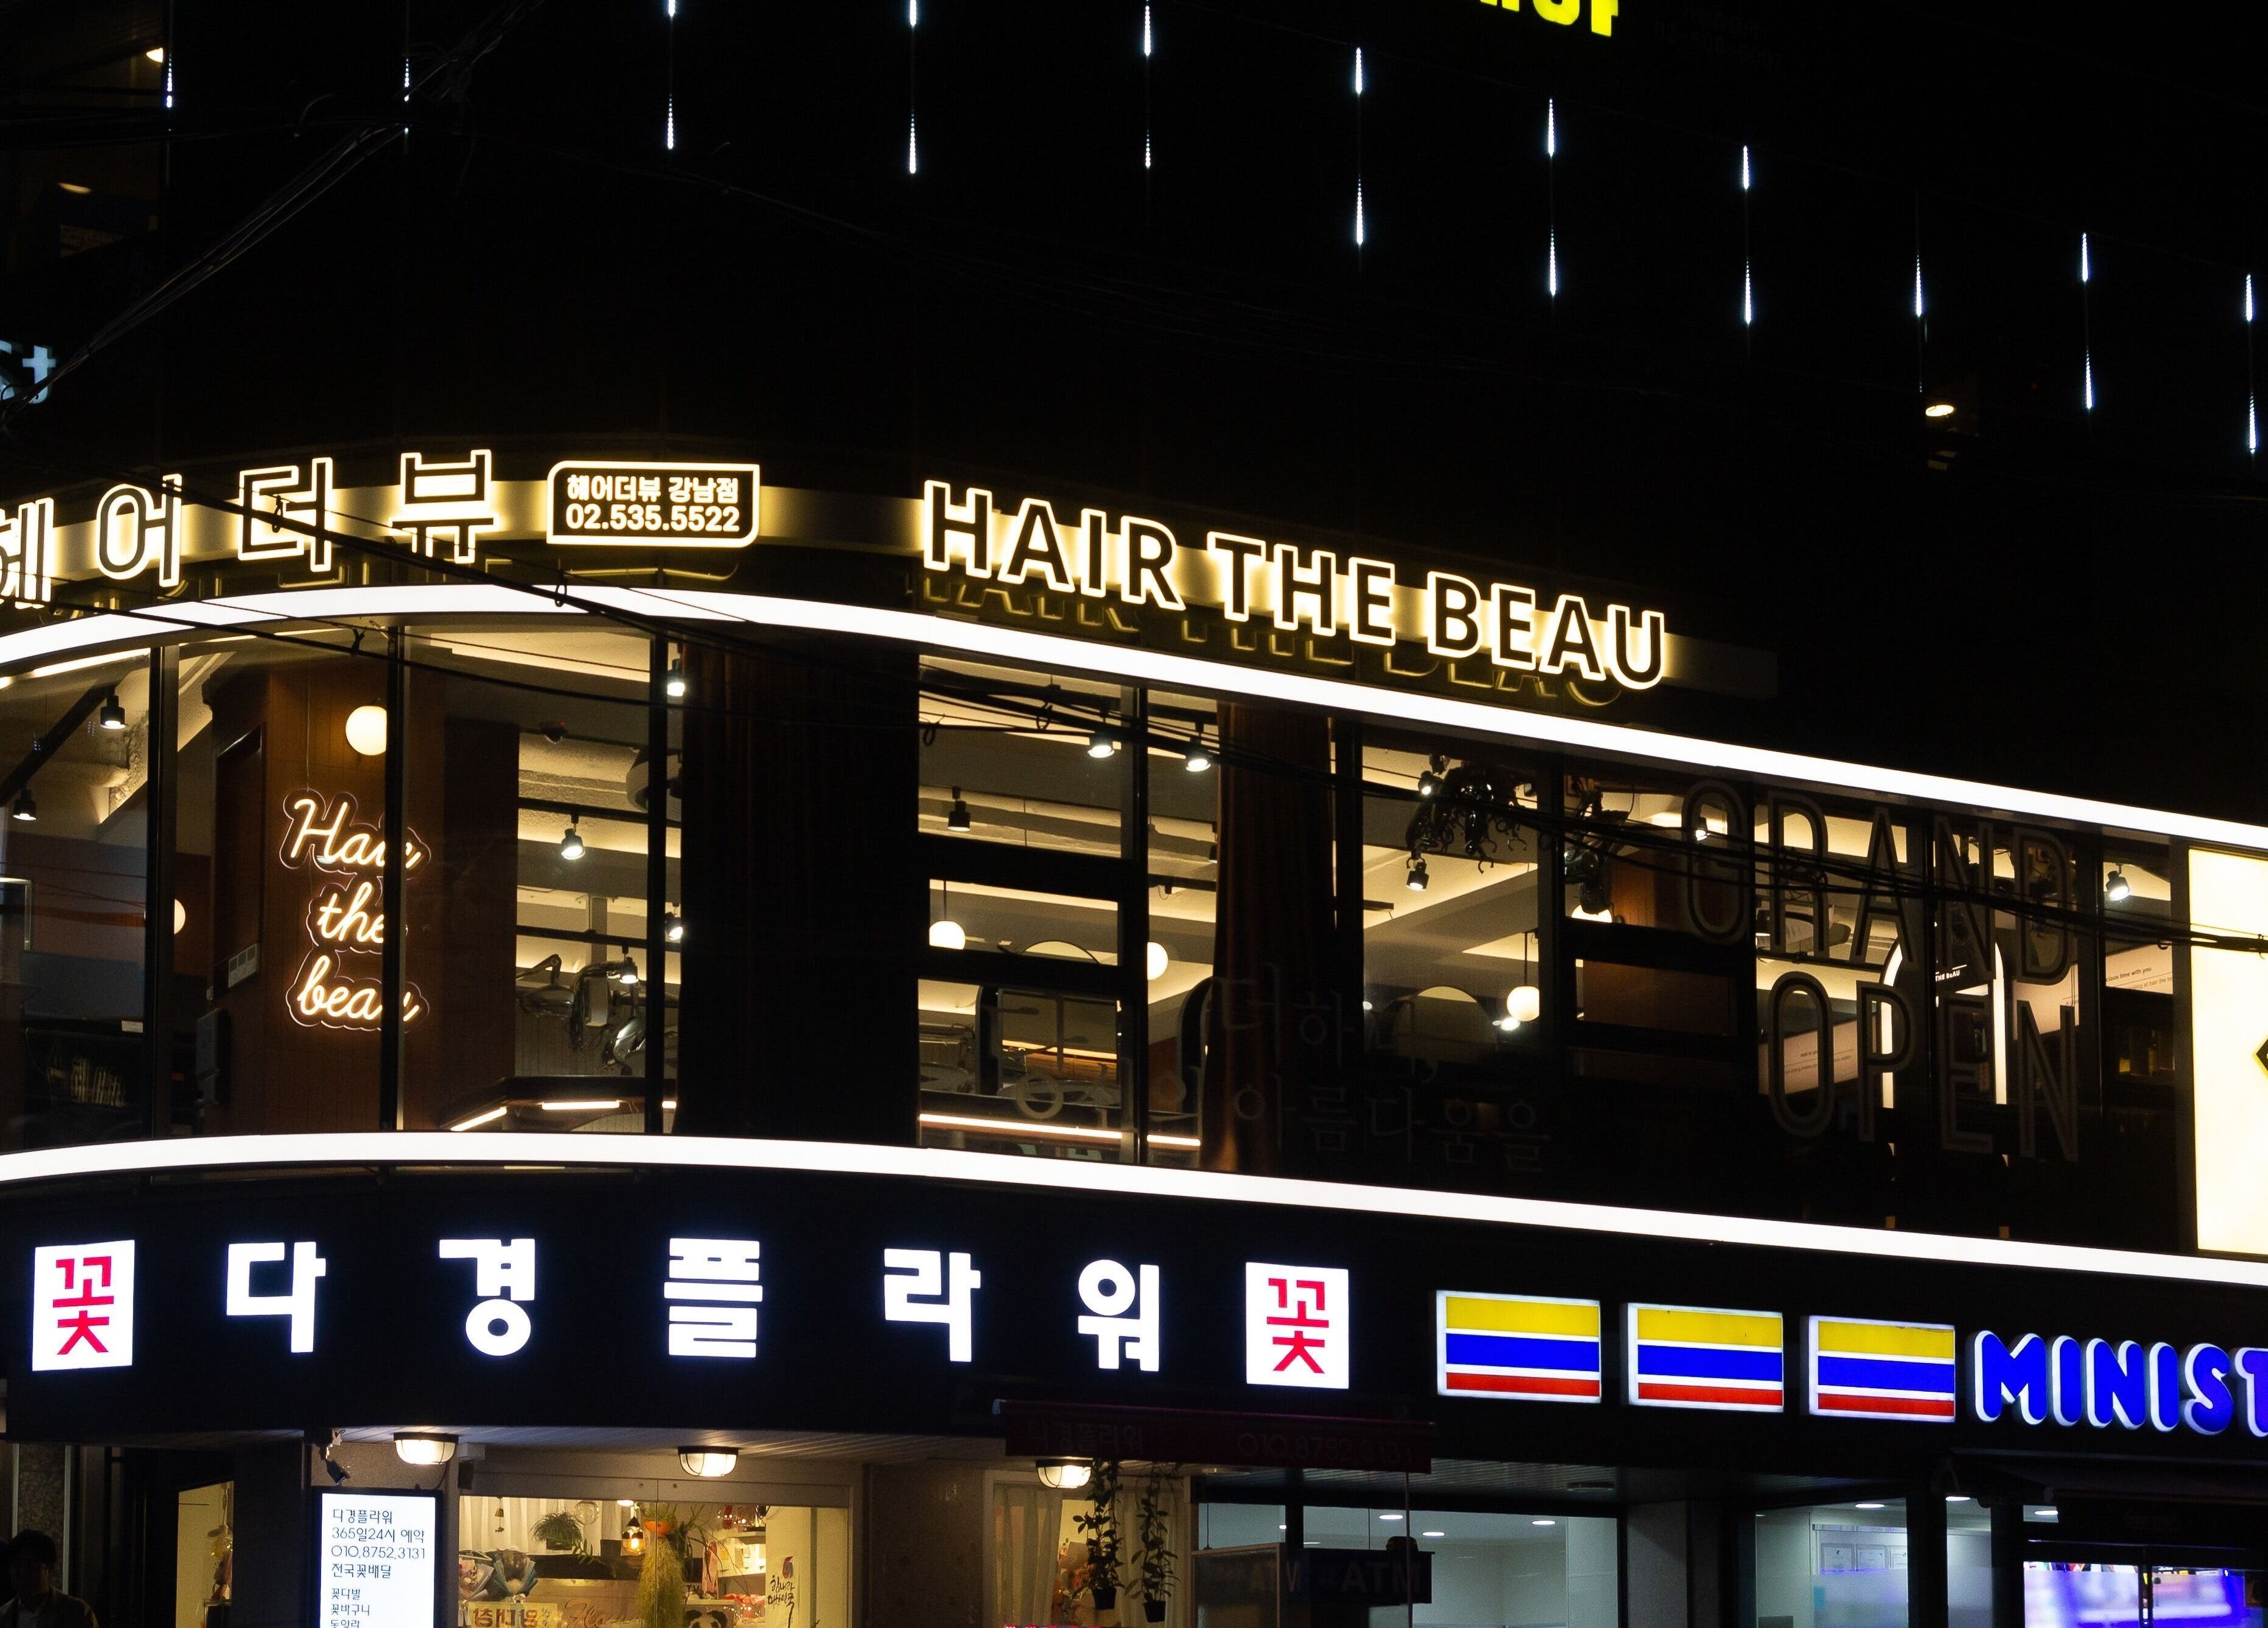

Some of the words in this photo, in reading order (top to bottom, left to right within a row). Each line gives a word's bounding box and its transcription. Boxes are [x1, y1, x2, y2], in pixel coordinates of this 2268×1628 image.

[567, 474, 662, 502] 헤어더뷰
[668, 476, 739, 504] 강남점
[565, 503, 740, 532] 02.535.5522
[924, 480, 1185, 611] HAIR
[1207, 531, 1396, 647] THE
[1426, 571, 1665, 690] BEAU
[1681, 780, 2076, 985] GRAND
[297, 955, 420, 1022] bea
[1768, 971, 2079, 1162] OPEN
[52, 1256, 115, 1355] 꽃
[226, 1237, 1160, 1373] 다경플라워
[1266, 1276, 1329, 1374] 꽃
[333, 1509, 392, 1524] 다경플라워
[332, 1527, 395, 1542] 365일24시
[400, 1529, 424, 1543] 예약
[331, 1545, 425, 1559] 010.8752.3131
[331, 1563, 391, 1579] 전국꽃배달
[331, 1588, 361, 1600] 꽃다발
[331, 1604, 370, 1616] 꽃바구니
